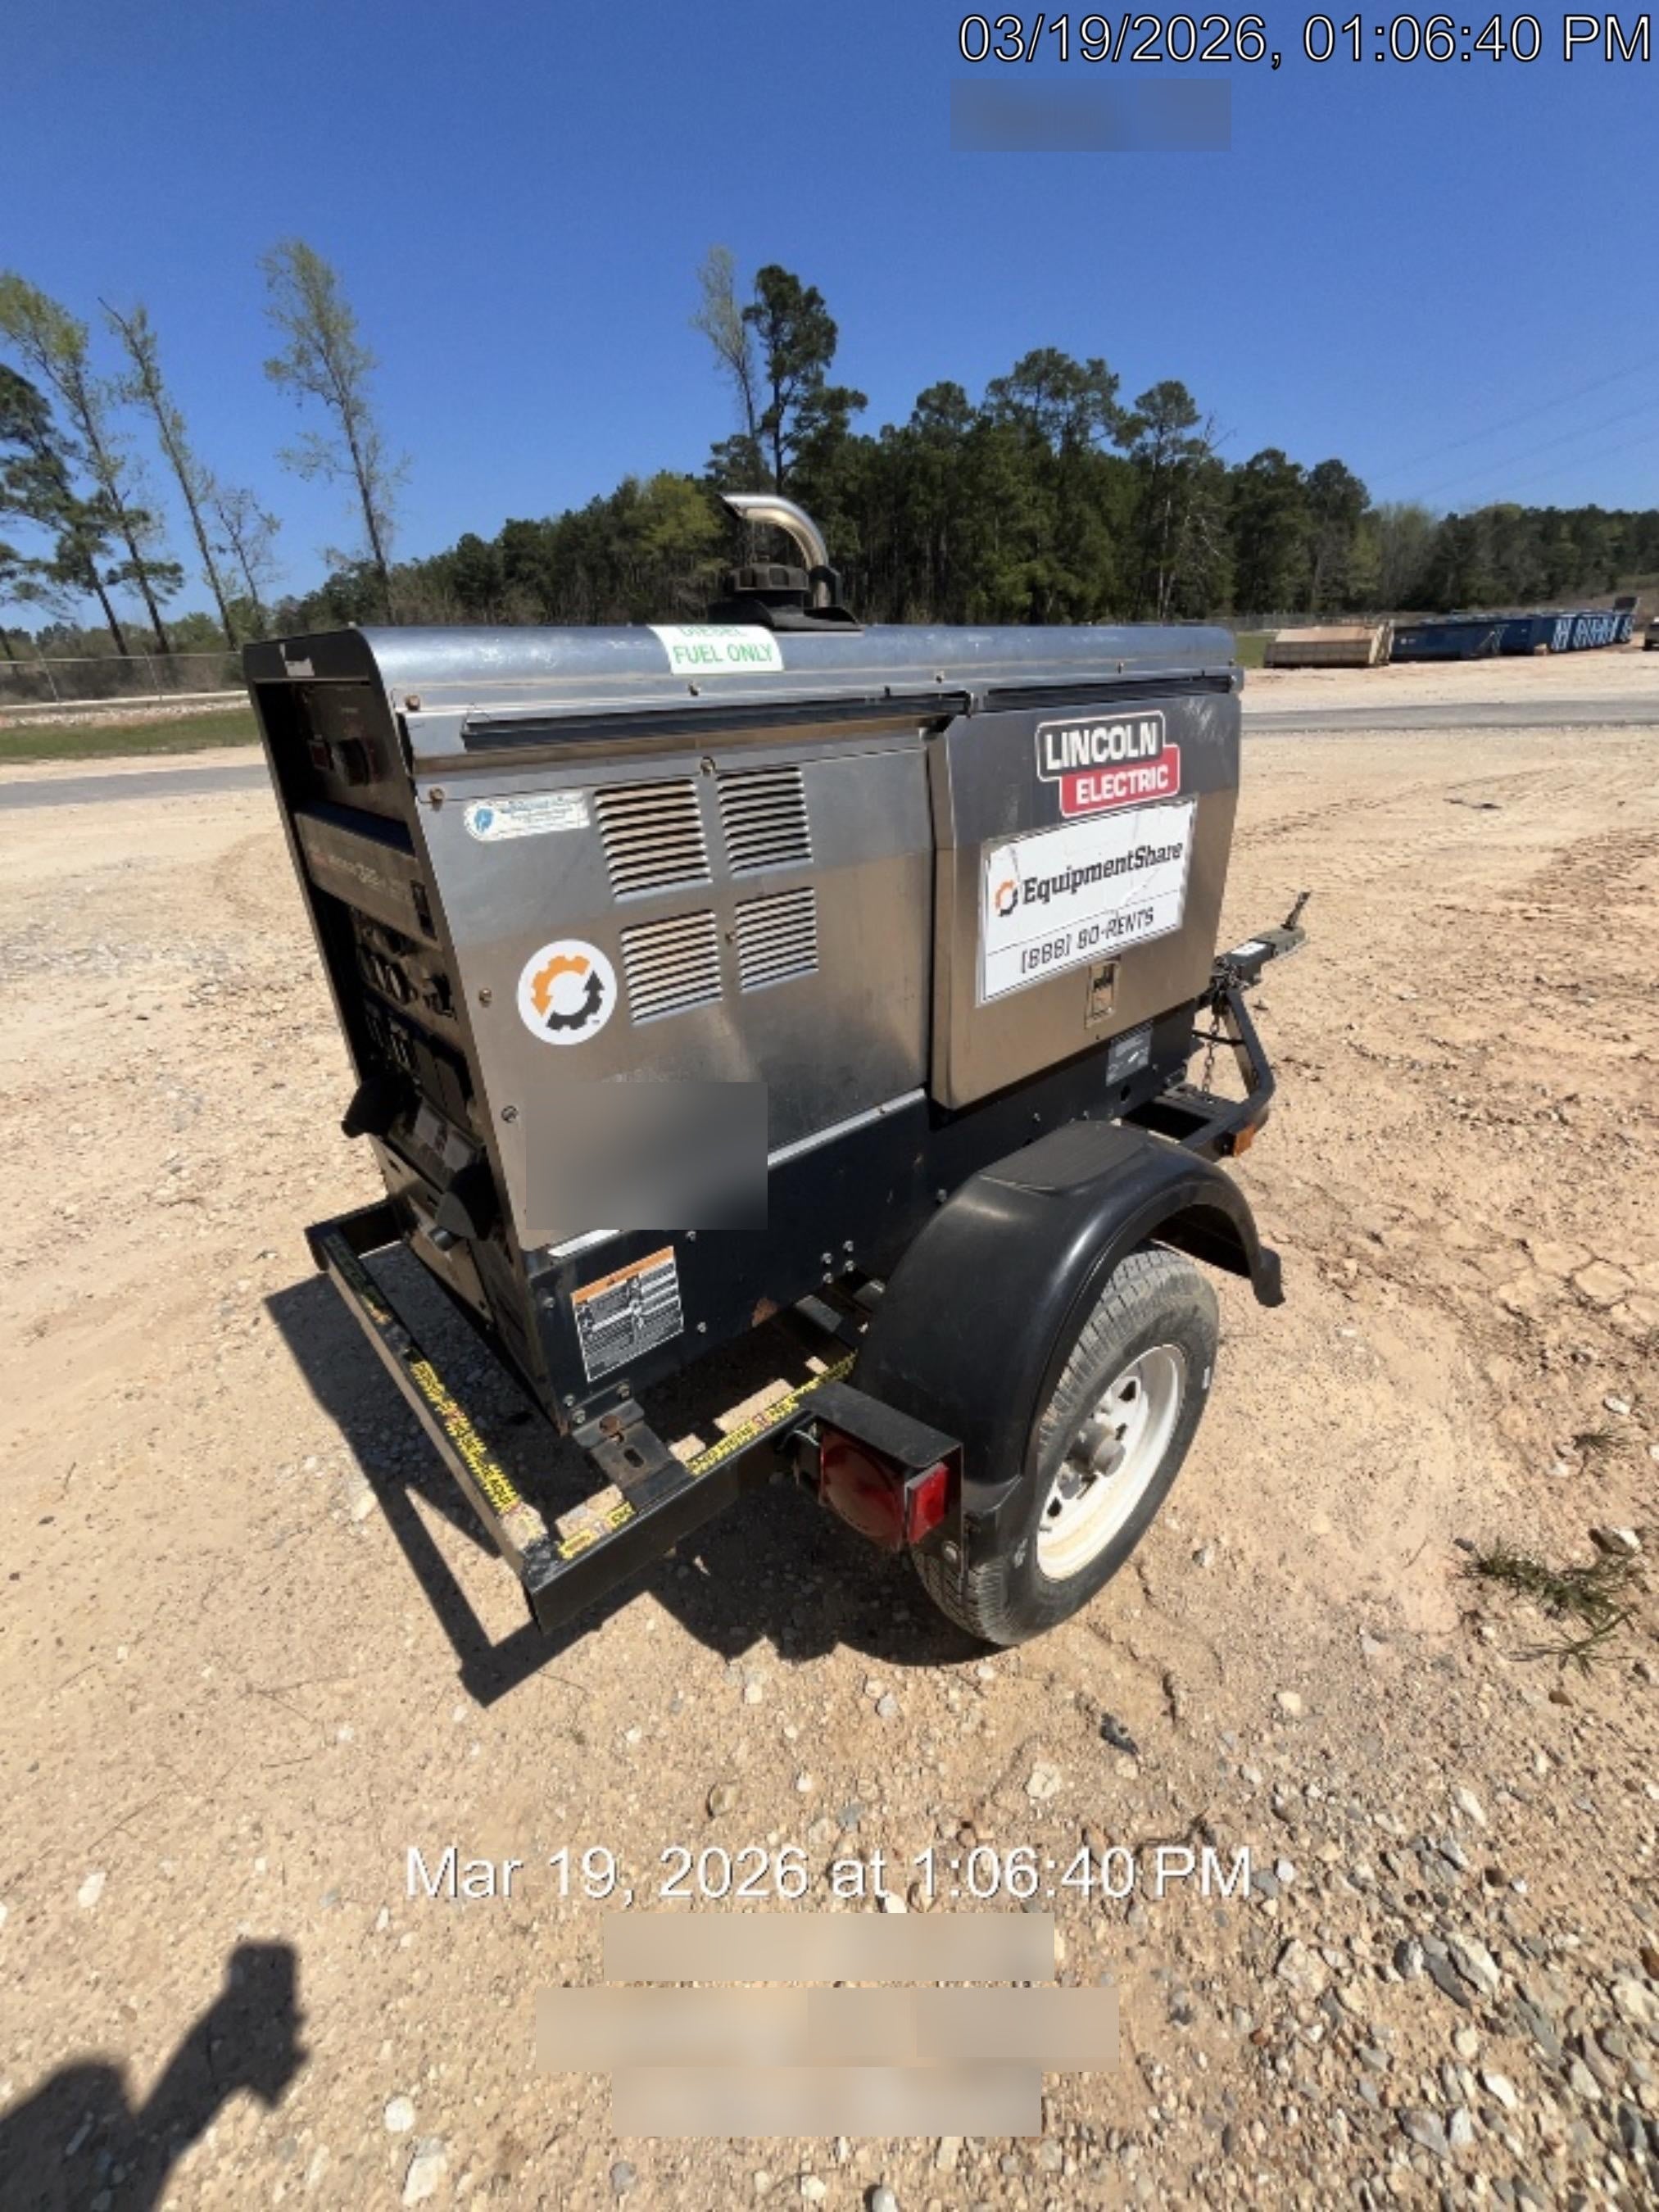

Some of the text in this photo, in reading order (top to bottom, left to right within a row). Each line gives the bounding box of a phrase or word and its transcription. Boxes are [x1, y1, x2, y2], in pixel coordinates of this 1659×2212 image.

[673, 644, 773, 664] FUEL ONLY
[1045, 722, 1158, 772] LINCOLN
[1076, 764, 1169, 805] ELECTRIC
[1022, 842, 1184, 904] EquipmentShare
